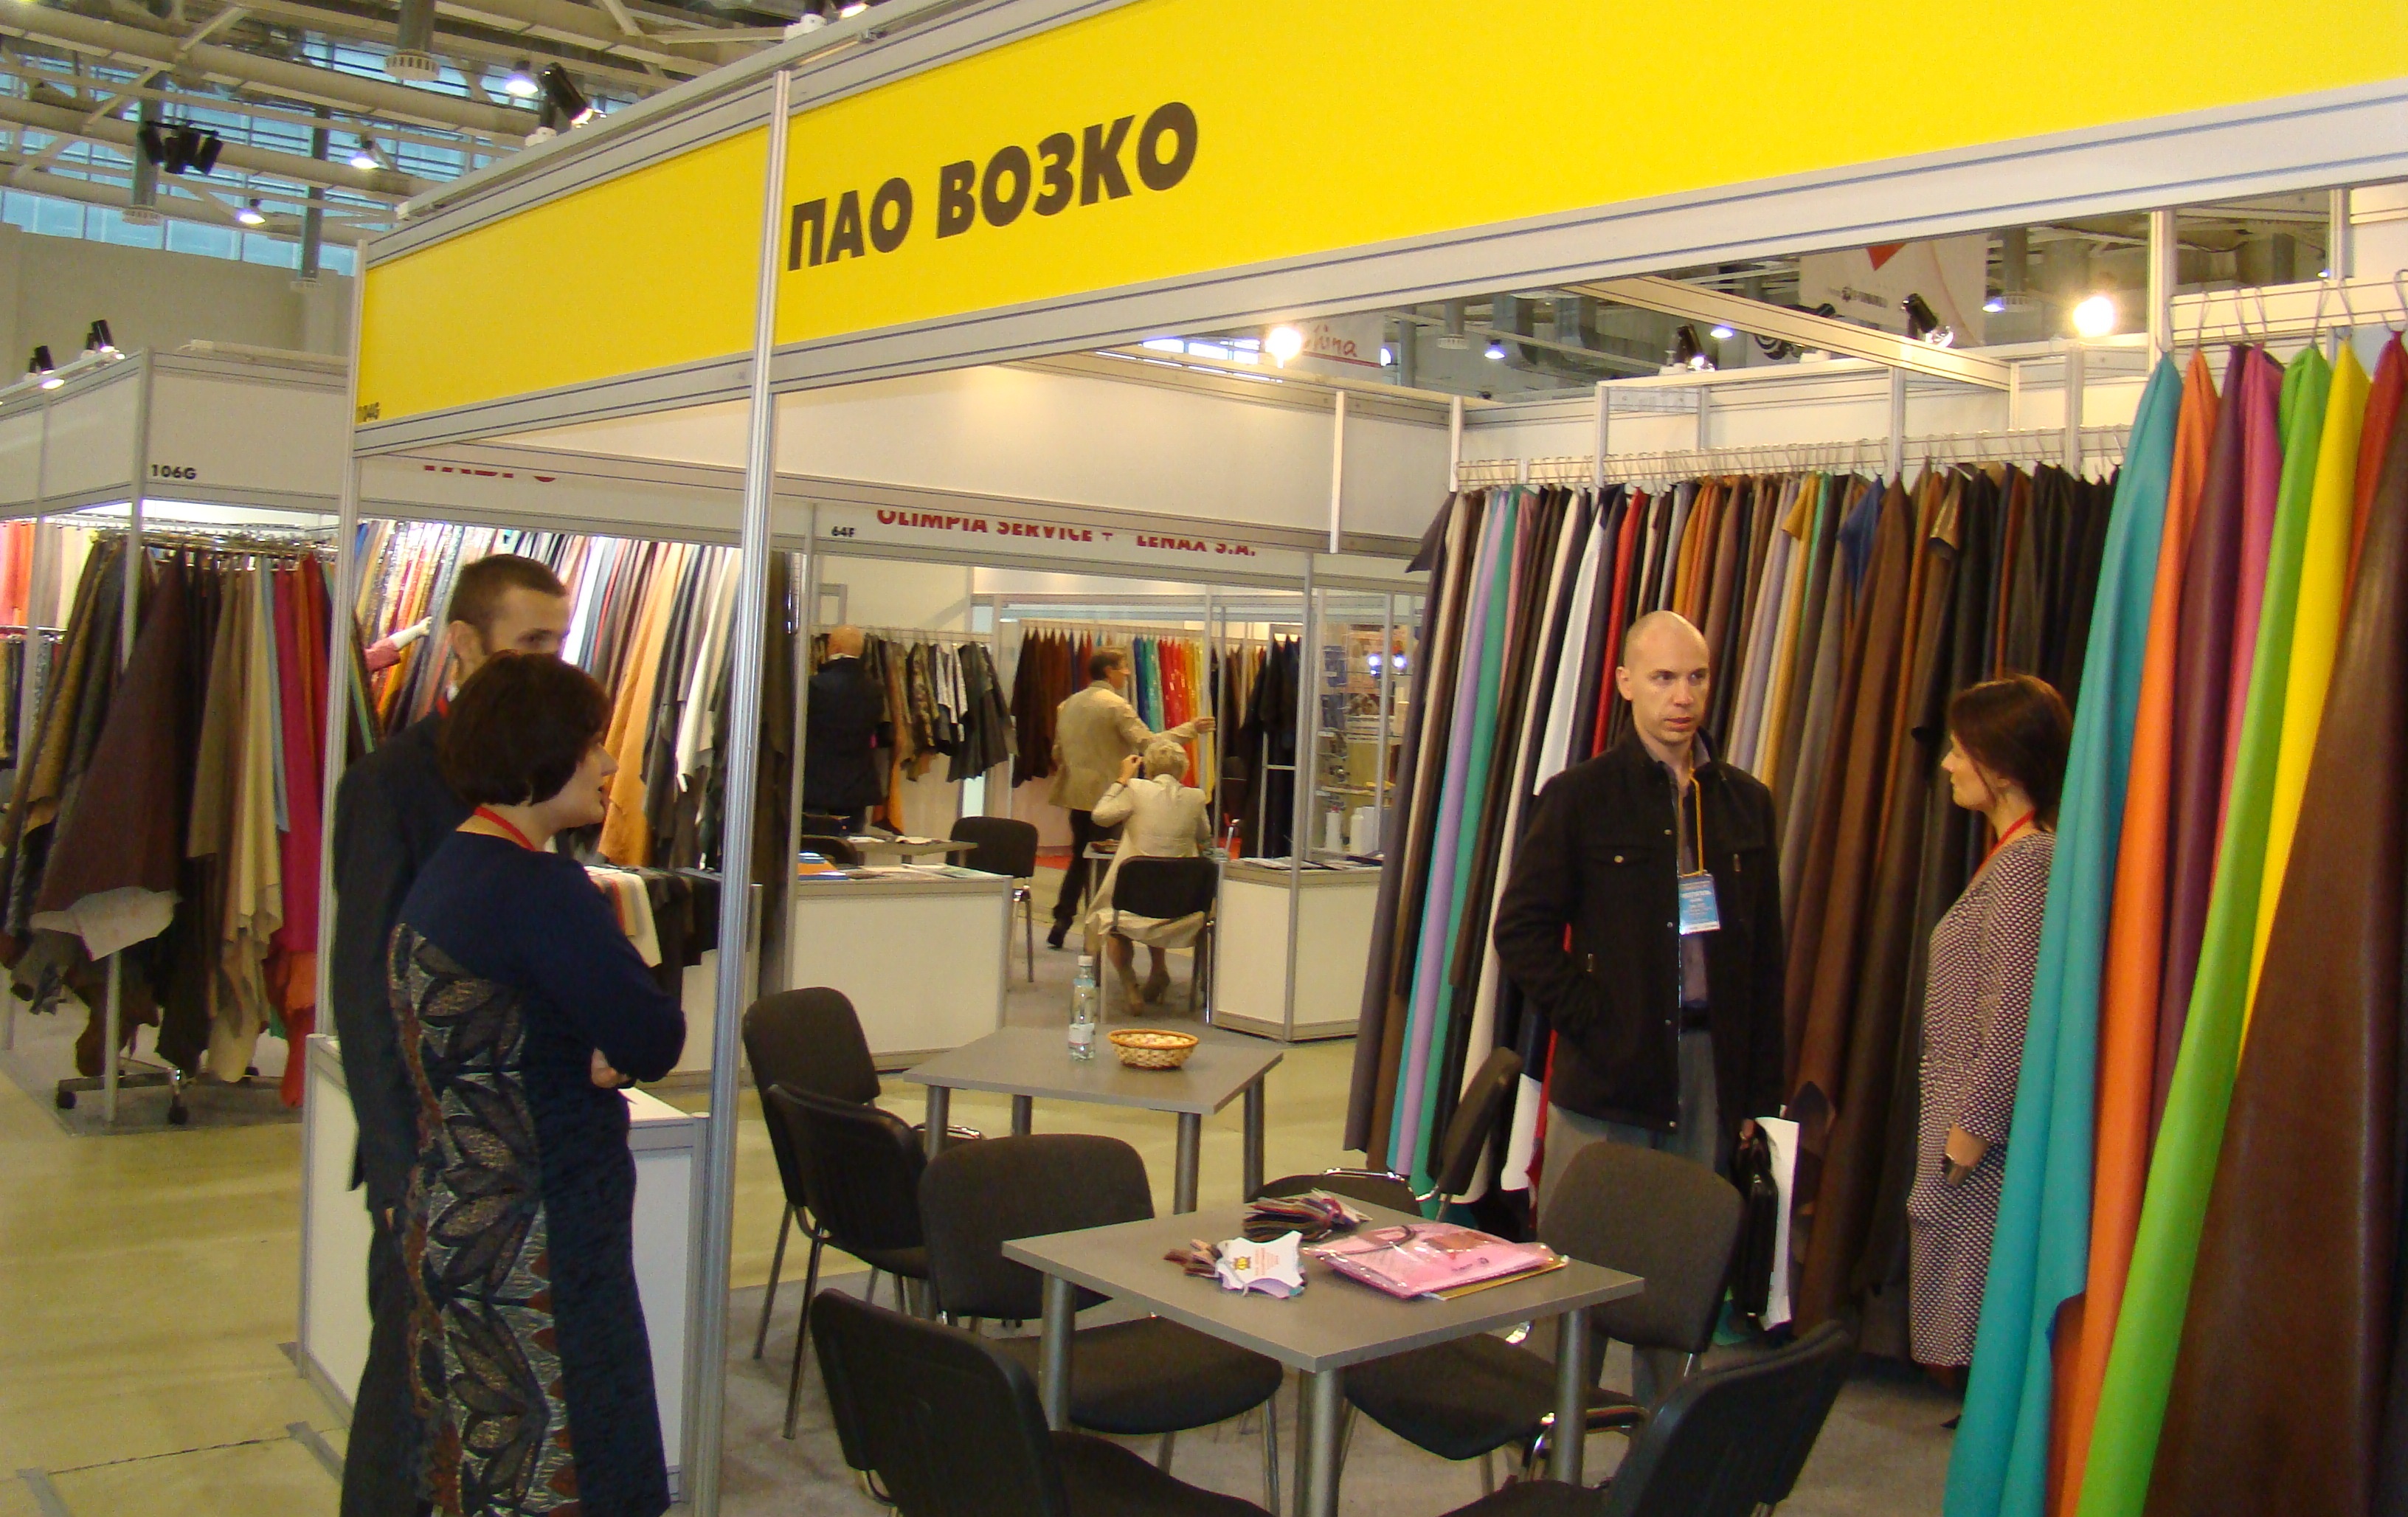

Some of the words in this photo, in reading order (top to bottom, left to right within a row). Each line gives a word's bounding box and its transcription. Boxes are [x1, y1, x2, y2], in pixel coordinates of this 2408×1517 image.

[787, 176, 913, 272] ПАО
[935, 101, 1198, 240] ВОЗКО
[151, 464, 197, 480] 106G
[831, 525, 856, 538] 64F
[876, 509, 989, 533] OLIMPIA
[996, 521, 1092, 542] SERVICE
